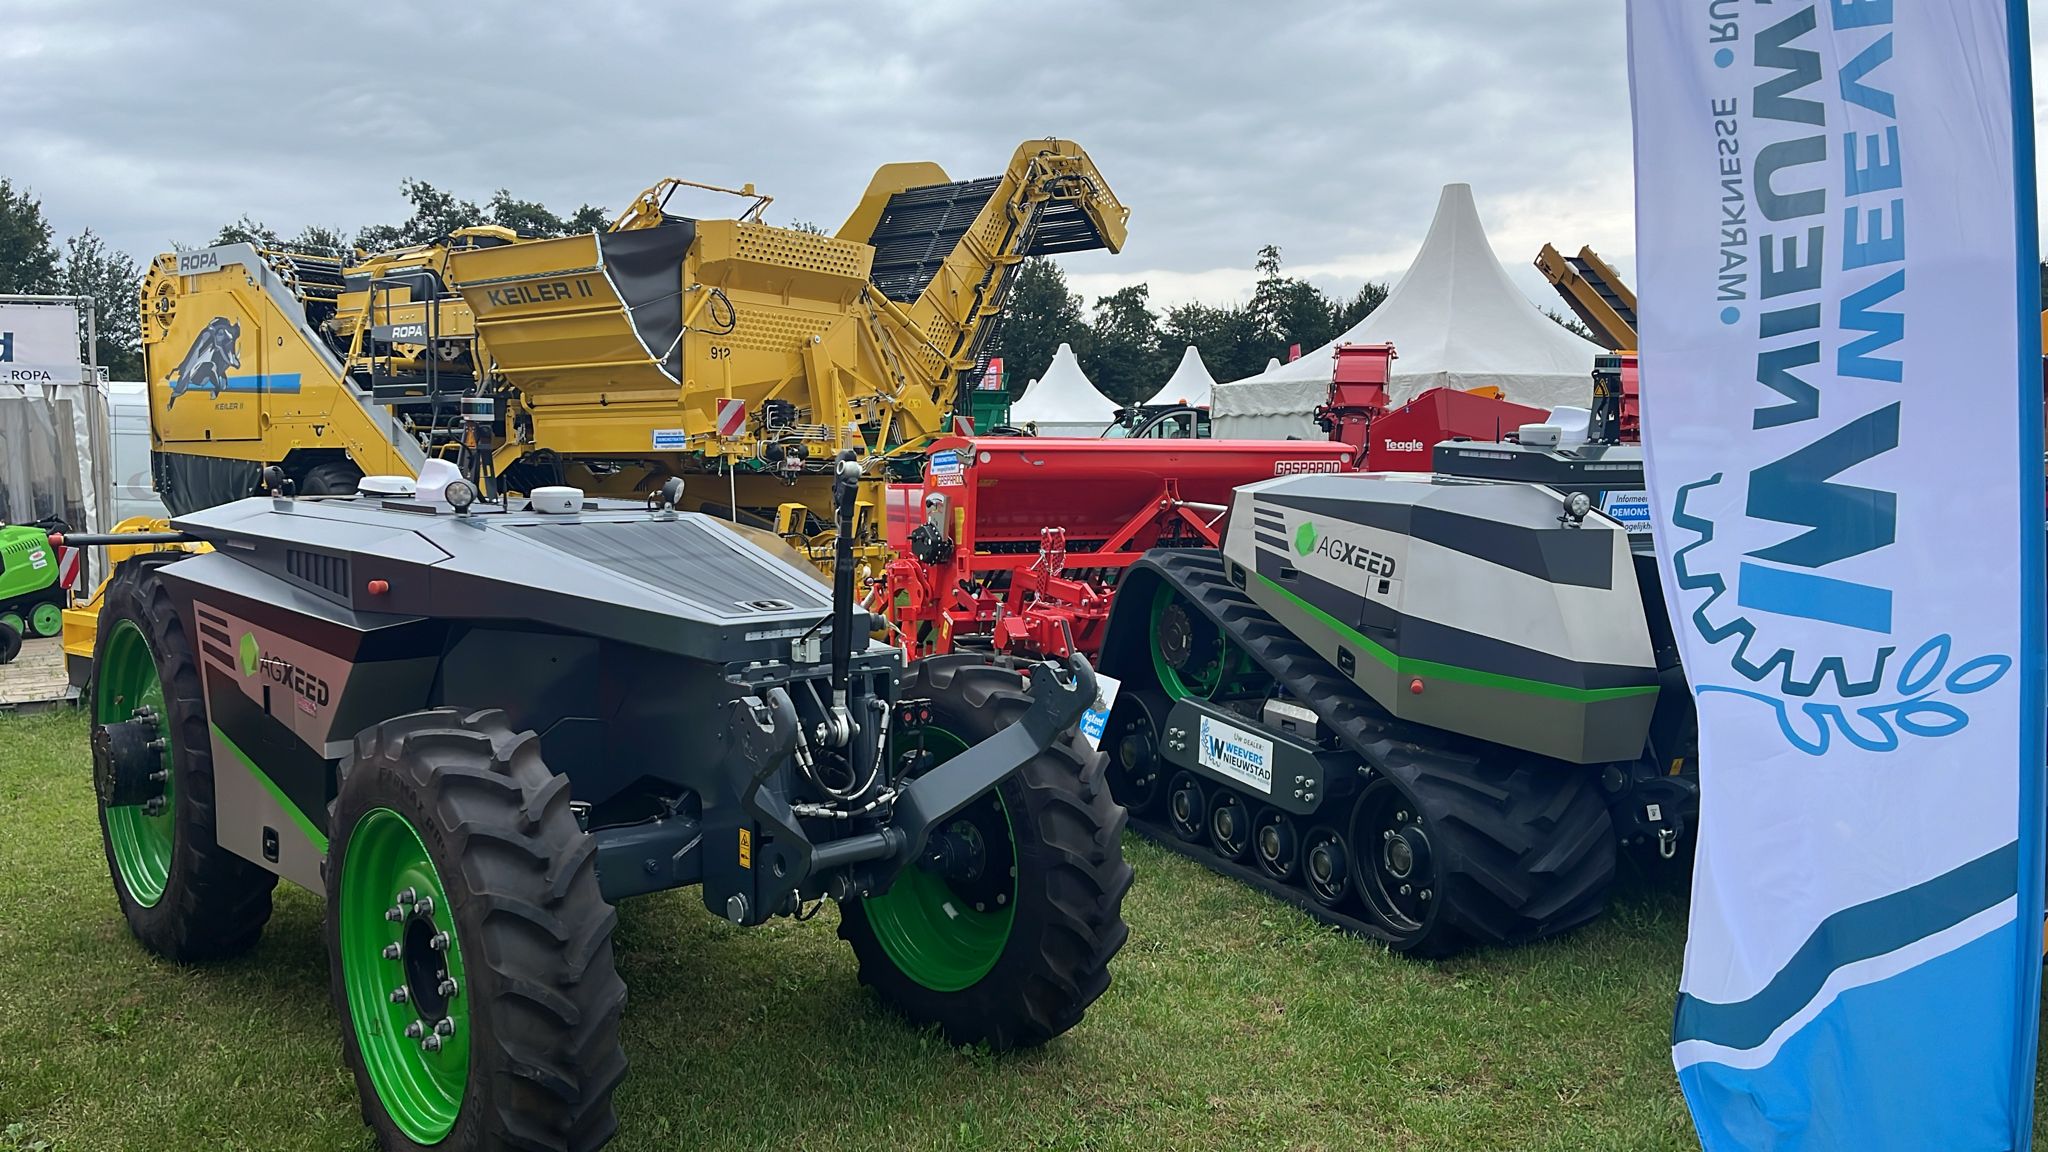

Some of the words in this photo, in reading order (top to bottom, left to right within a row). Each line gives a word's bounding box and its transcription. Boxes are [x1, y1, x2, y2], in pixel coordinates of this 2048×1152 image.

[180, 251, 218, 272] ROPA
[487, 282, 572, 306] KEILER
[575, 279, 594, 297] II
[392, 325, 423, 339] ROPA
[710, 346, 731, 360] 912
[11, 370, 51, 380] ROPA
[1384, 439, 1424, 452] Teagle
[1275, 461, 1341, 475] GASPARDO
[1611, 507, 1648, 517] DEMONS
[1316, 536, 1396, 578] AGXEED
[260, 651, 330, 707] AGXEED
[1225, 742, 1264, 766] WEEVERS
[1223, 752, 1271, 780] NIEUWSTAD
